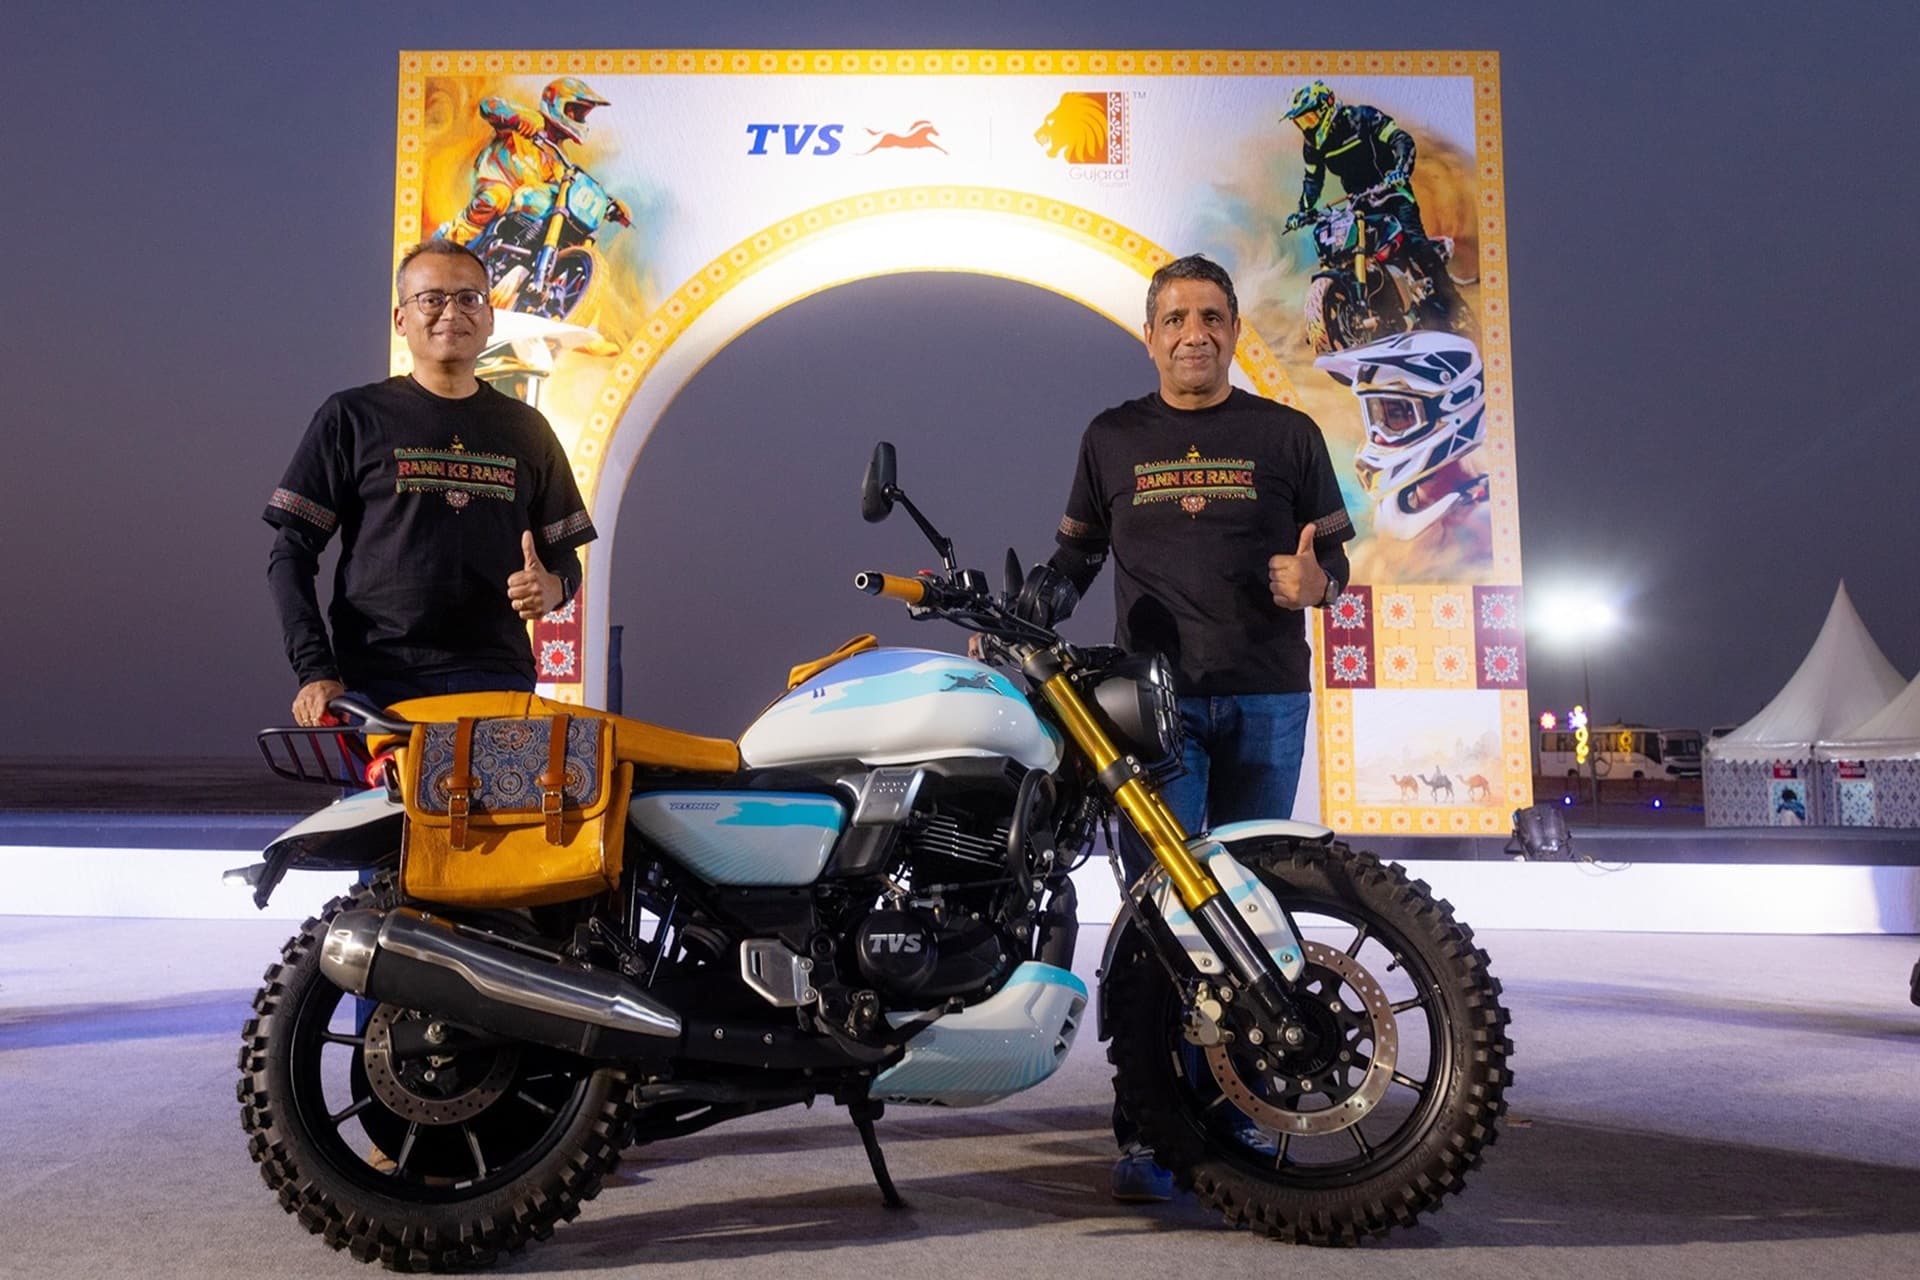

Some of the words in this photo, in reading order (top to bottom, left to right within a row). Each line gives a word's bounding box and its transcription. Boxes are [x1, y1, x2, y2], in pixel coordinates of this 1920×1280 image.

[746, 124, 844, 156] TVS
[1069, 167, 1129, 183] Gujarat
[398, 460, 445, 476] RANN
[448, 464, 469, 479] KE
[471, 463, 515, 485] RANG
[1136, 472, 1179, 490] RANN
[1183, 470, 1204, 486] KE
[869, 933, 922, 953] TVS
